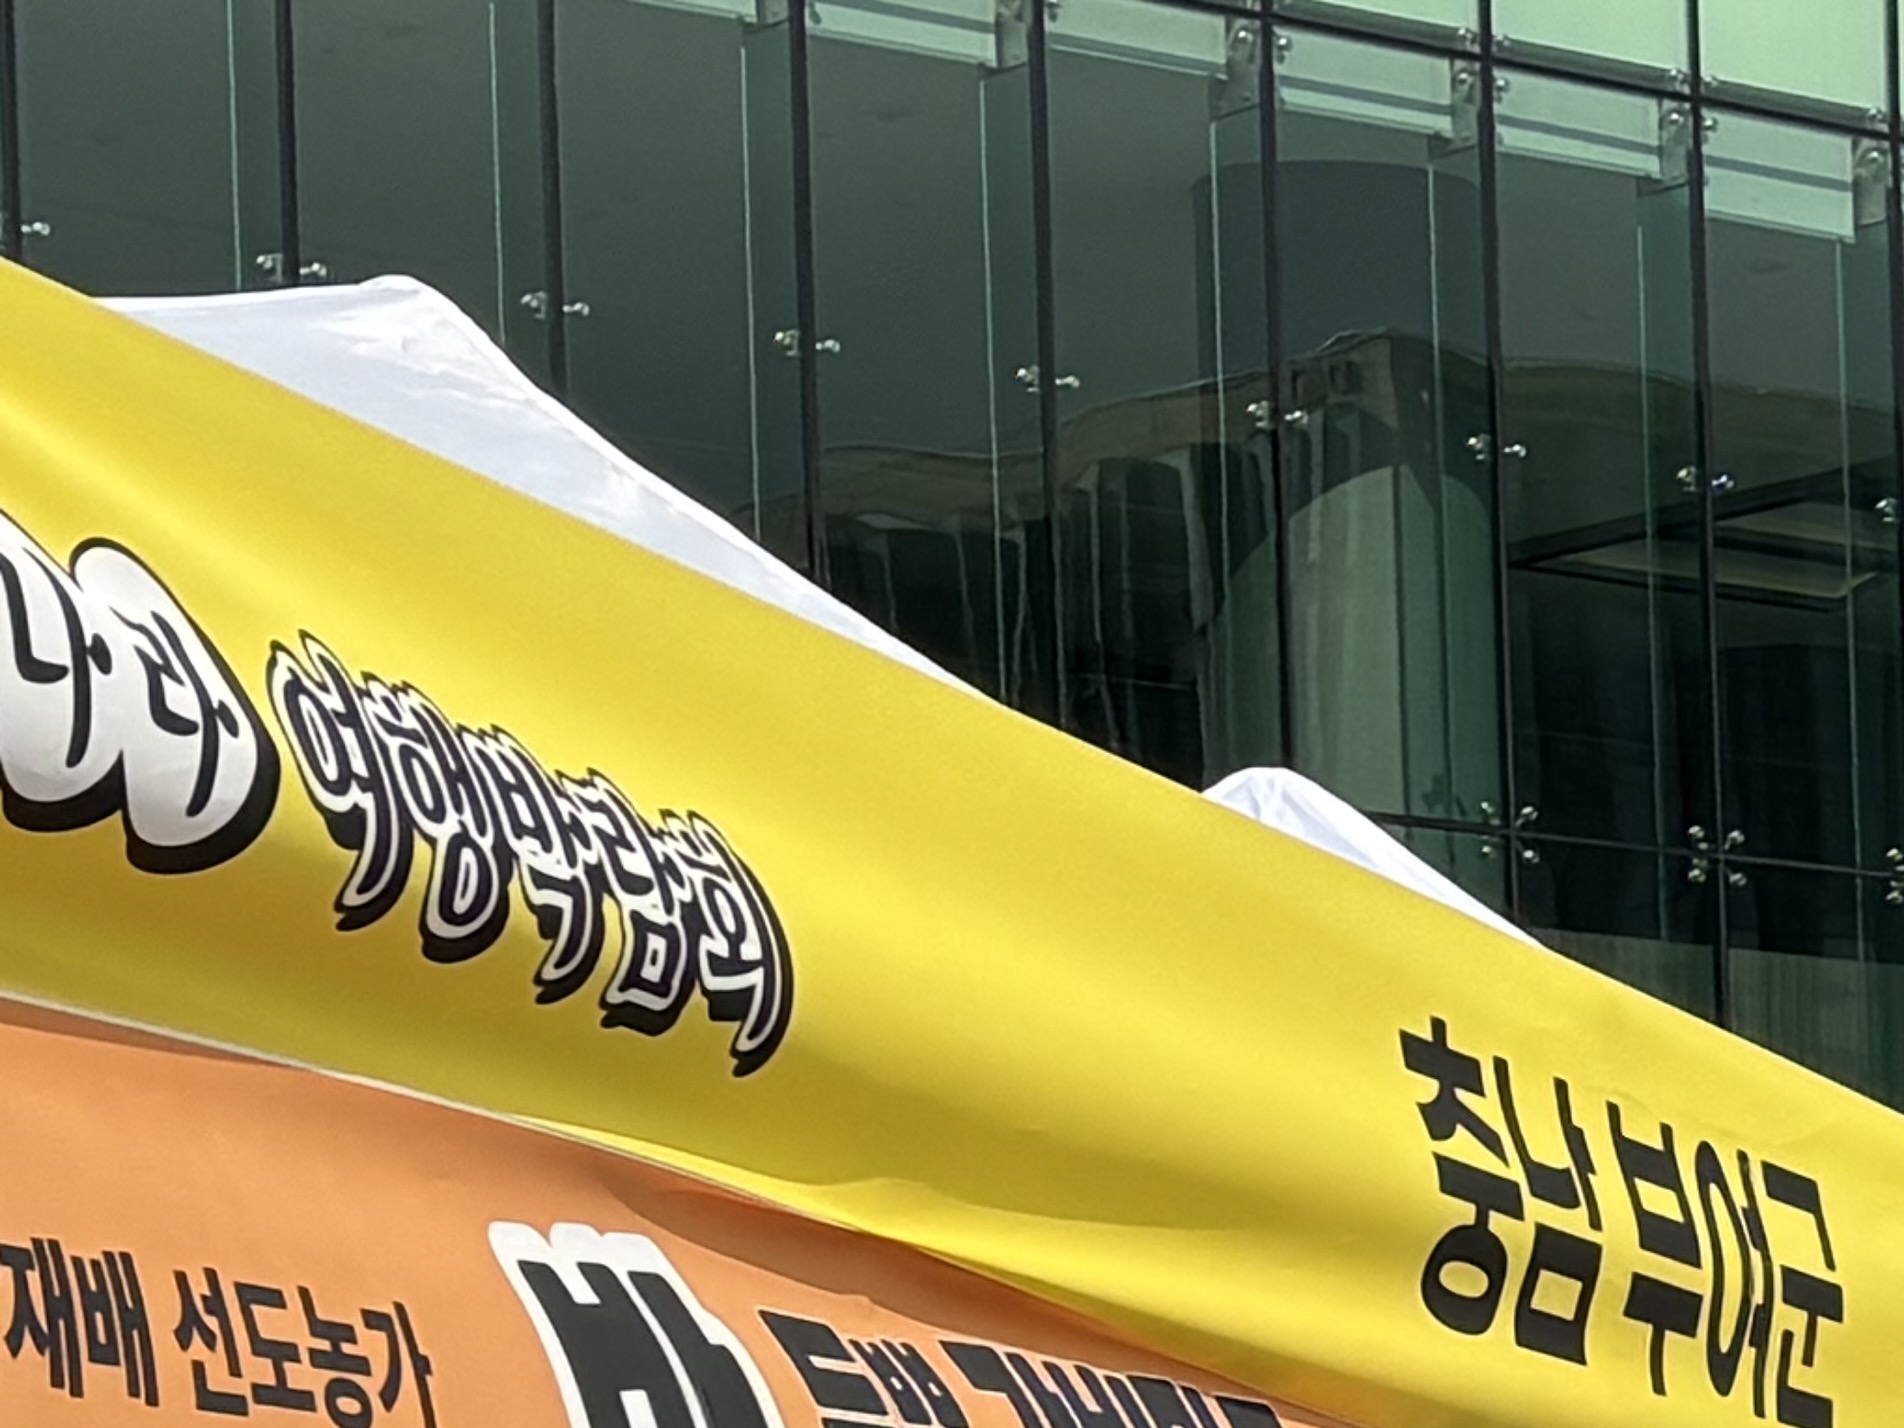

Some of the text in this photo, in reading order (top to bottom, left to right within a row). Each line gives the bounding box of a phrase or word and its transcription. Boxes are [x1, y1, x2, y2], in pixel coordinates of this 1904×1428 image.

[270, 635, 793, 1068] 여행박람회
[0, 1238, 158, 1407] 재배
[1398, 1016, 1604, 1366] 충남
